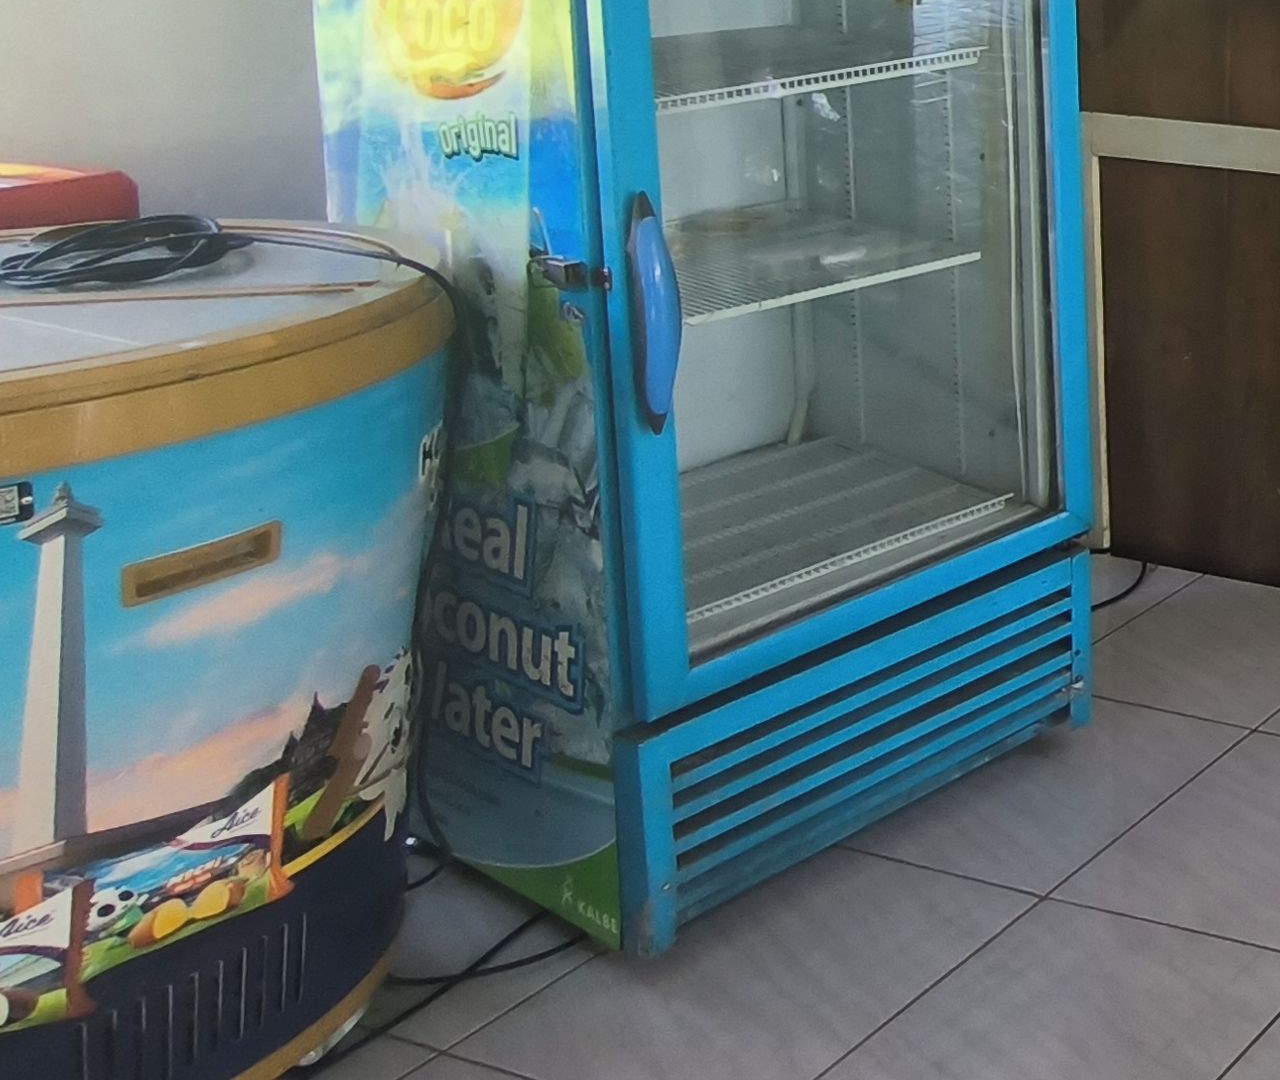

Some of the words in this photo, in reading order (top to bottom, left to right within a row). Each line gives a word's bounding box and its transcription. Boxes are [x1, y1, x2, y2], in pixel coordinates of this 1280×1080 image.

[438, 113, 518, 158] original
[442, 502, 529, 581] eal
[210, 806, 261, 839] Aice
